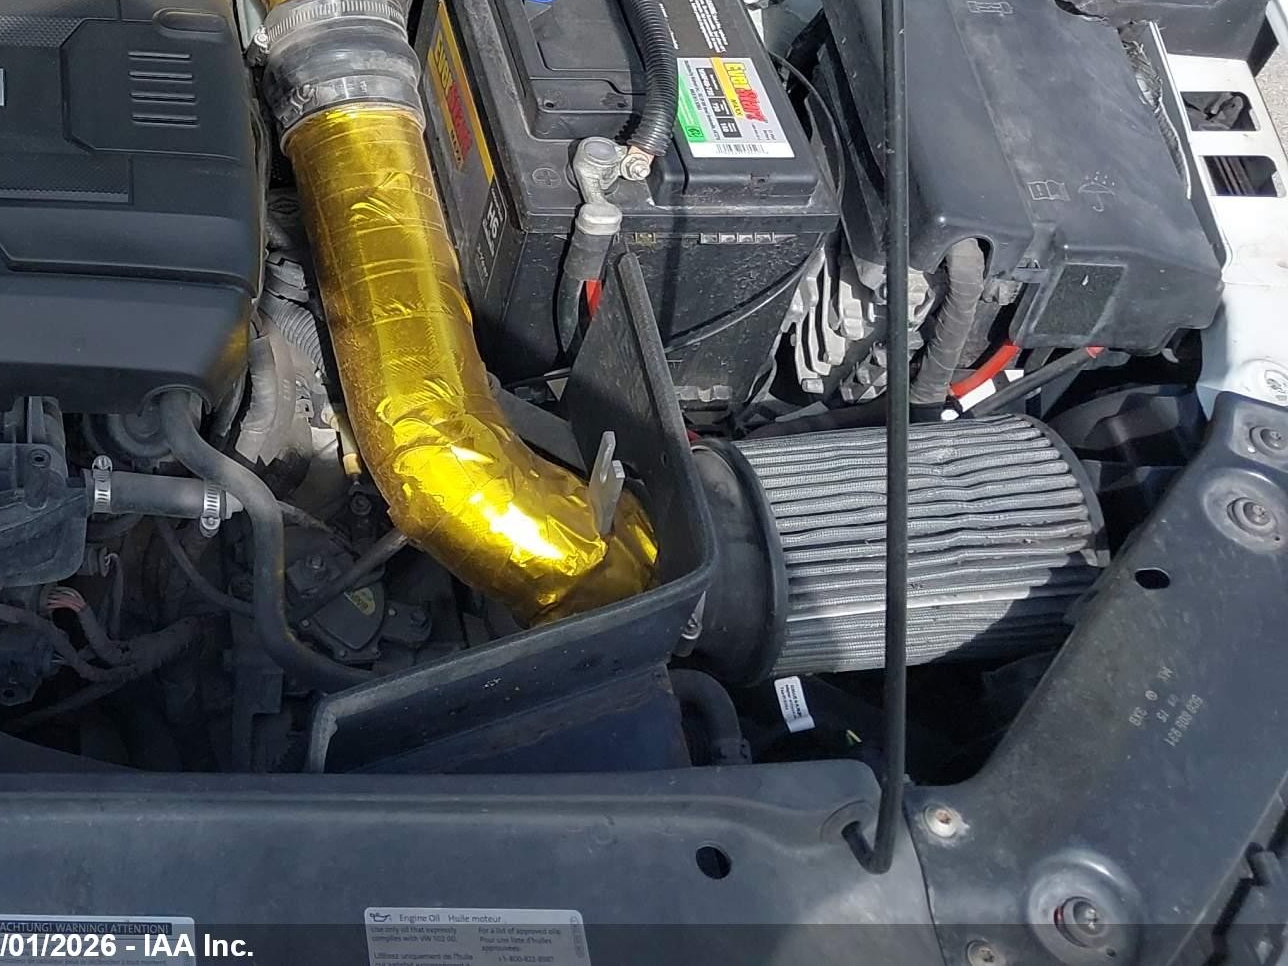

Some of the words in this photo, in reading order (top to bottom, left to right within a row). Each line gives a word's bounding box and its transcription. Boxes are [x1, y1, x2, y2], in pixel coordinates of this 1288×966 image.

[399, 914, 427, 924] Engine
[428, 914, 440, 923] Oil
[448, 915, 470, 923] Huile
[0, 921, 53, 933] ACHTUNG!
[55, 922, 108, 933] WARNING!
[109, 923, 169, 935] ATTENTION!
